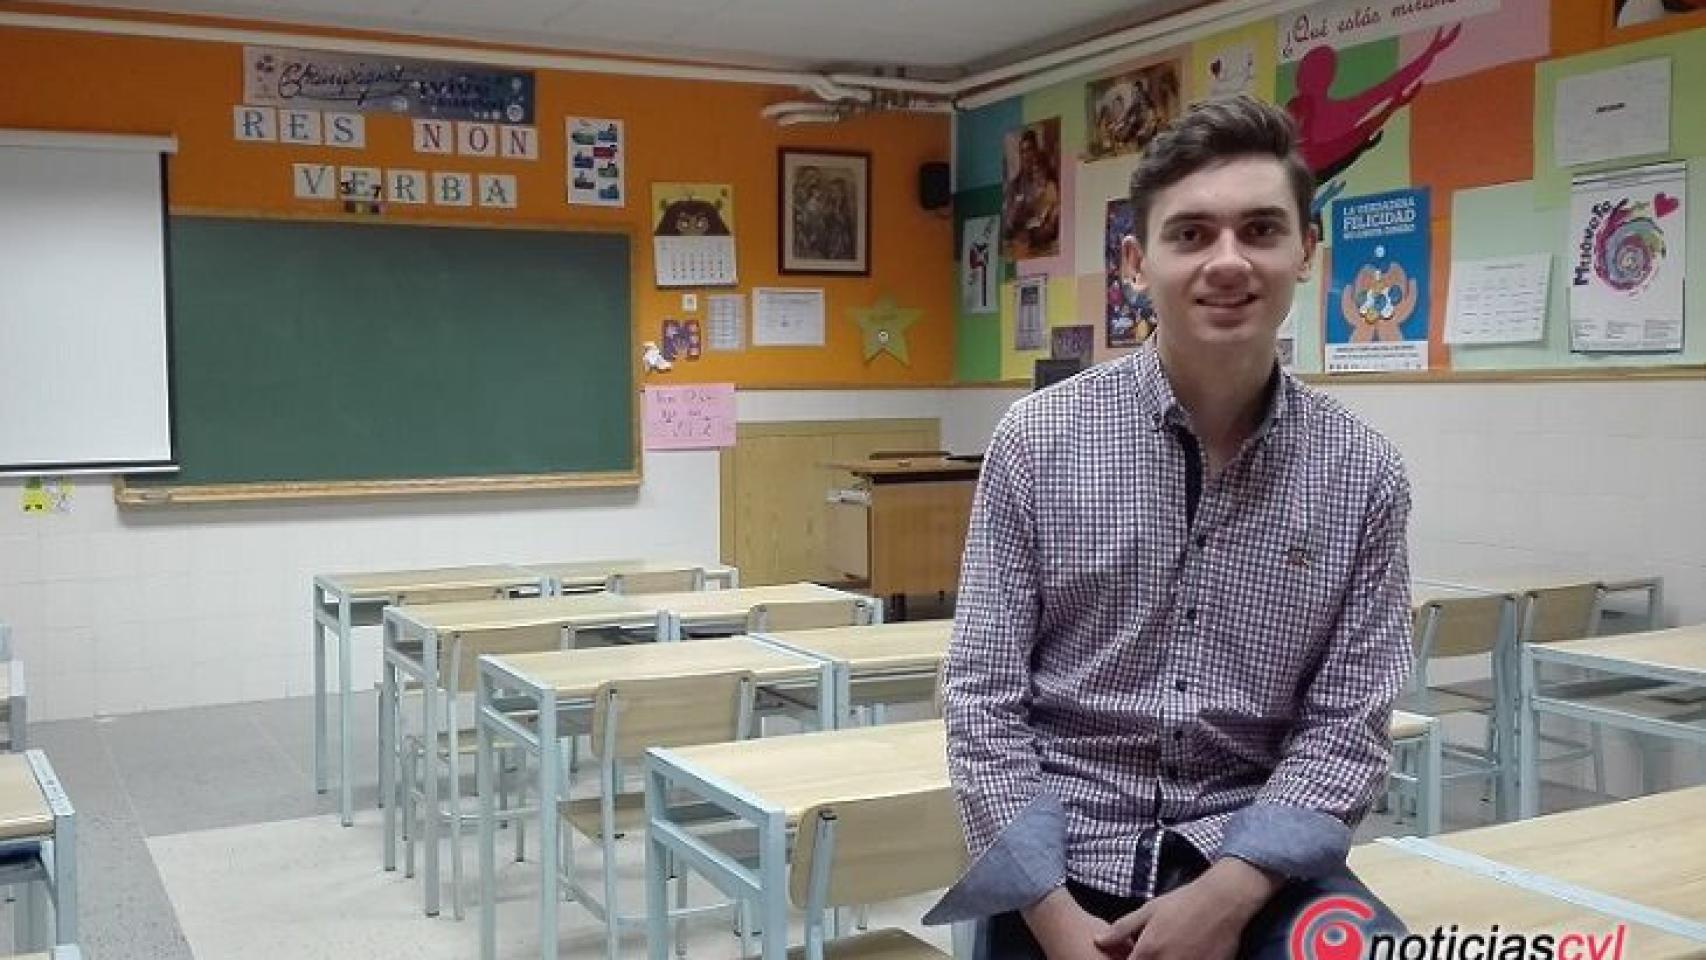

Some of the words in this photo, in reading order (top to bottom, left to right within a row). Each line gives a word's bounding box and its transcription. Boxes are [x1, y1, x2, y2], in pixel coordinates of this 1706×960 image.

[242, 111, 353, 143] RES
[422, 123, 527, 155] NON
[303, 167, 506, 204] VERBA
